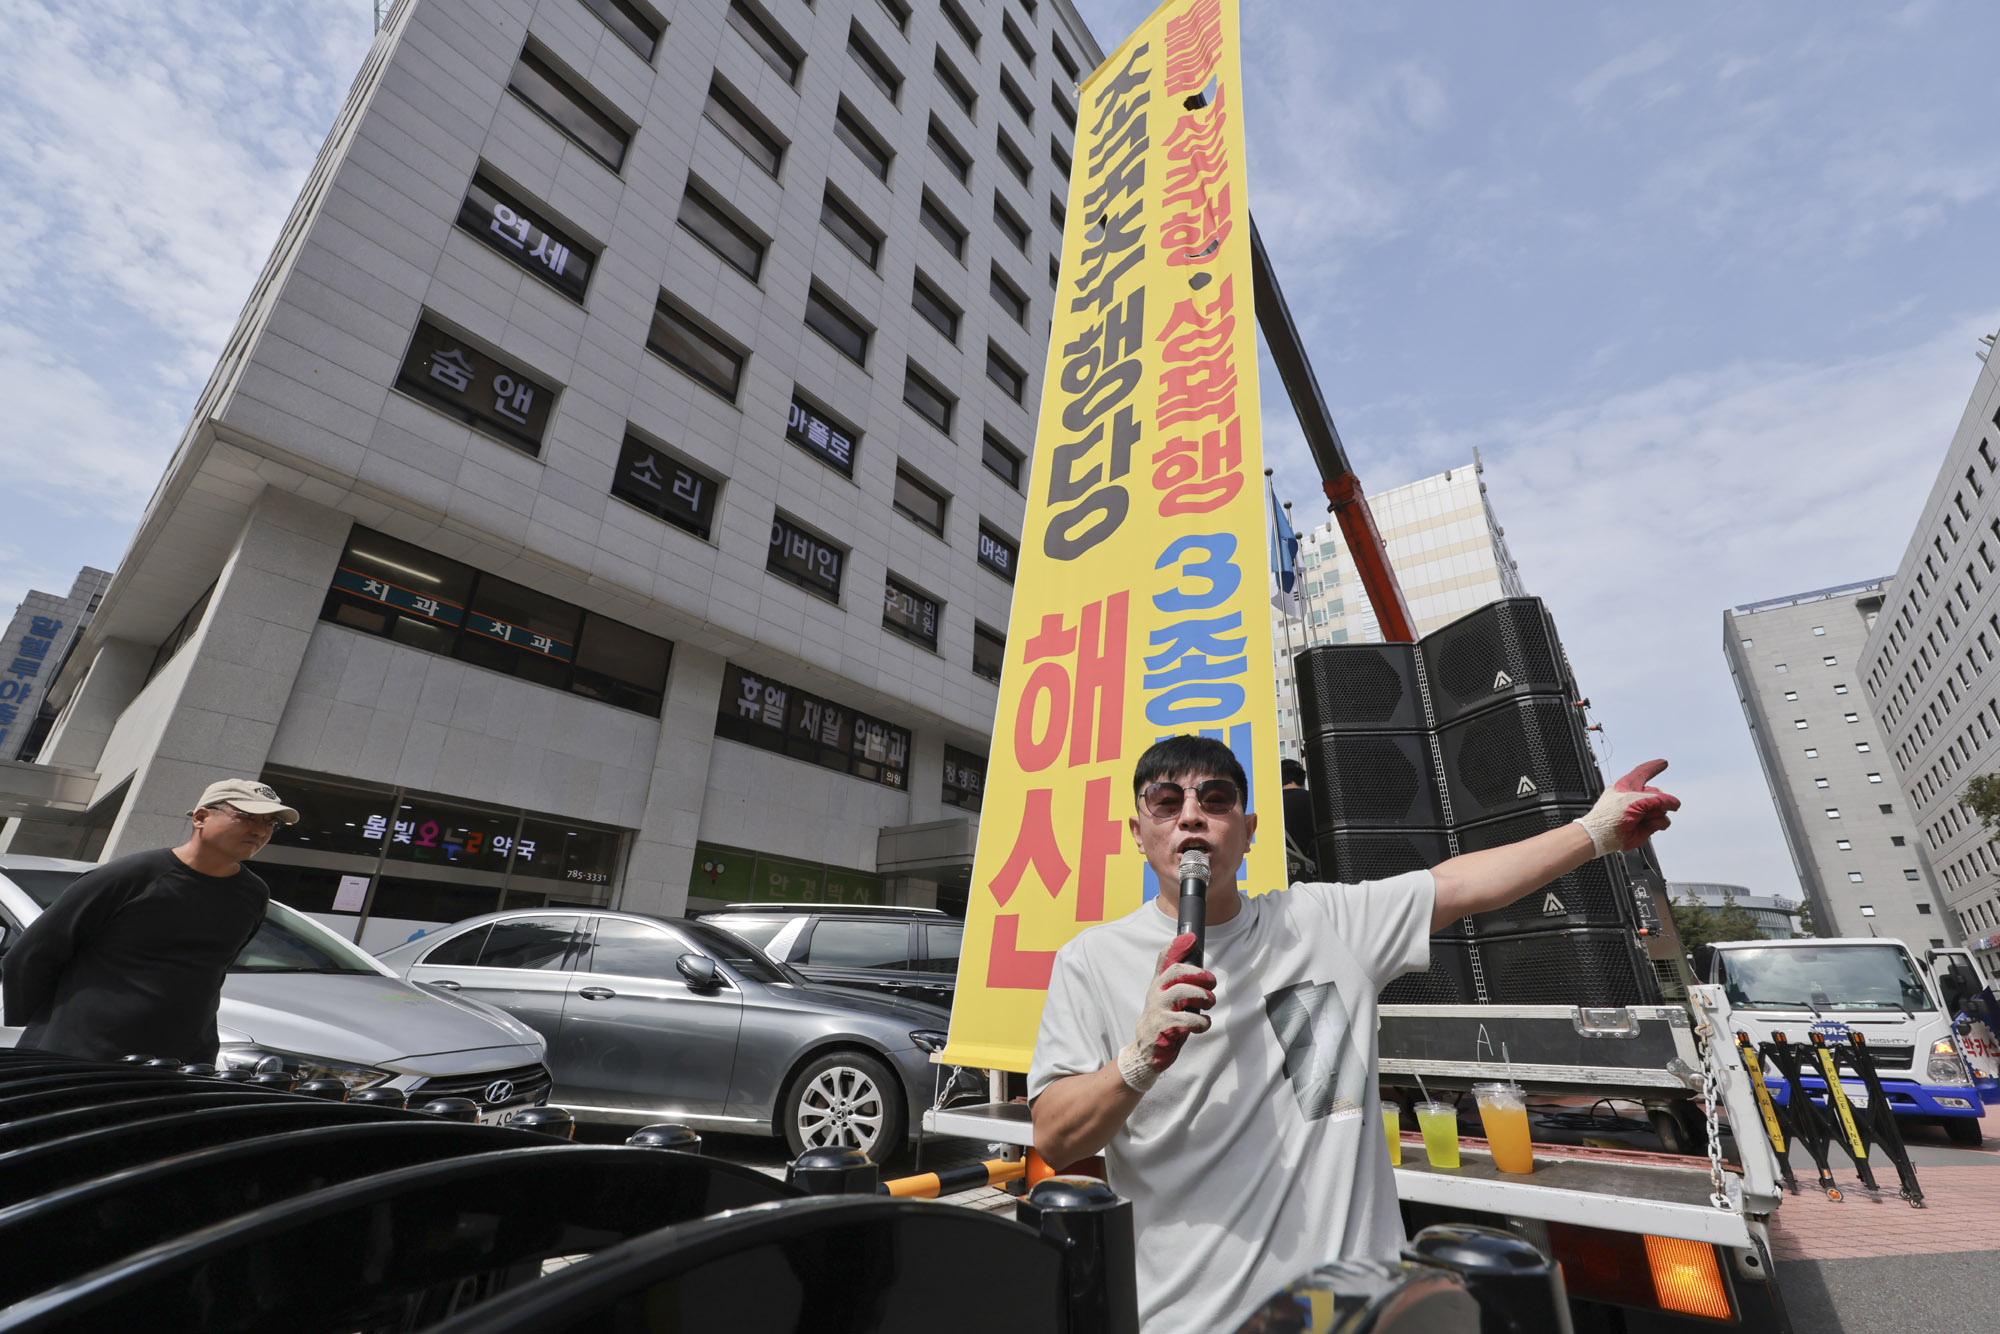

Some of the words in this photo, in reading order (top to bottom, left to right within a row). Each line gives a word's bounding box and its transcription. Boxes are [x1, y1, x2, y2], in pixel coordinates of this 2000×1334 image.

[490, 203, 570, 276] 연세
[787, 402, 850, 465] 아폴로
[980, 534, 1008, 568] 여성
[770, 521, 838, 583] 이비인
[737, 675, 786, 729] 휴엘
[800, 700, 843, 747] 재활
[854, 718, 907, 768] 의학과
[886, 771, 901, 785] 의원
[986, 589, 1131, 990] 해산
[567, 869, 607, 882] 785-3331
[1476, 1023, 1494, 1062] A
[1827, 1067, 1846, 1109] POLICE
[1845, 1118, 1859, 1146] LINE
